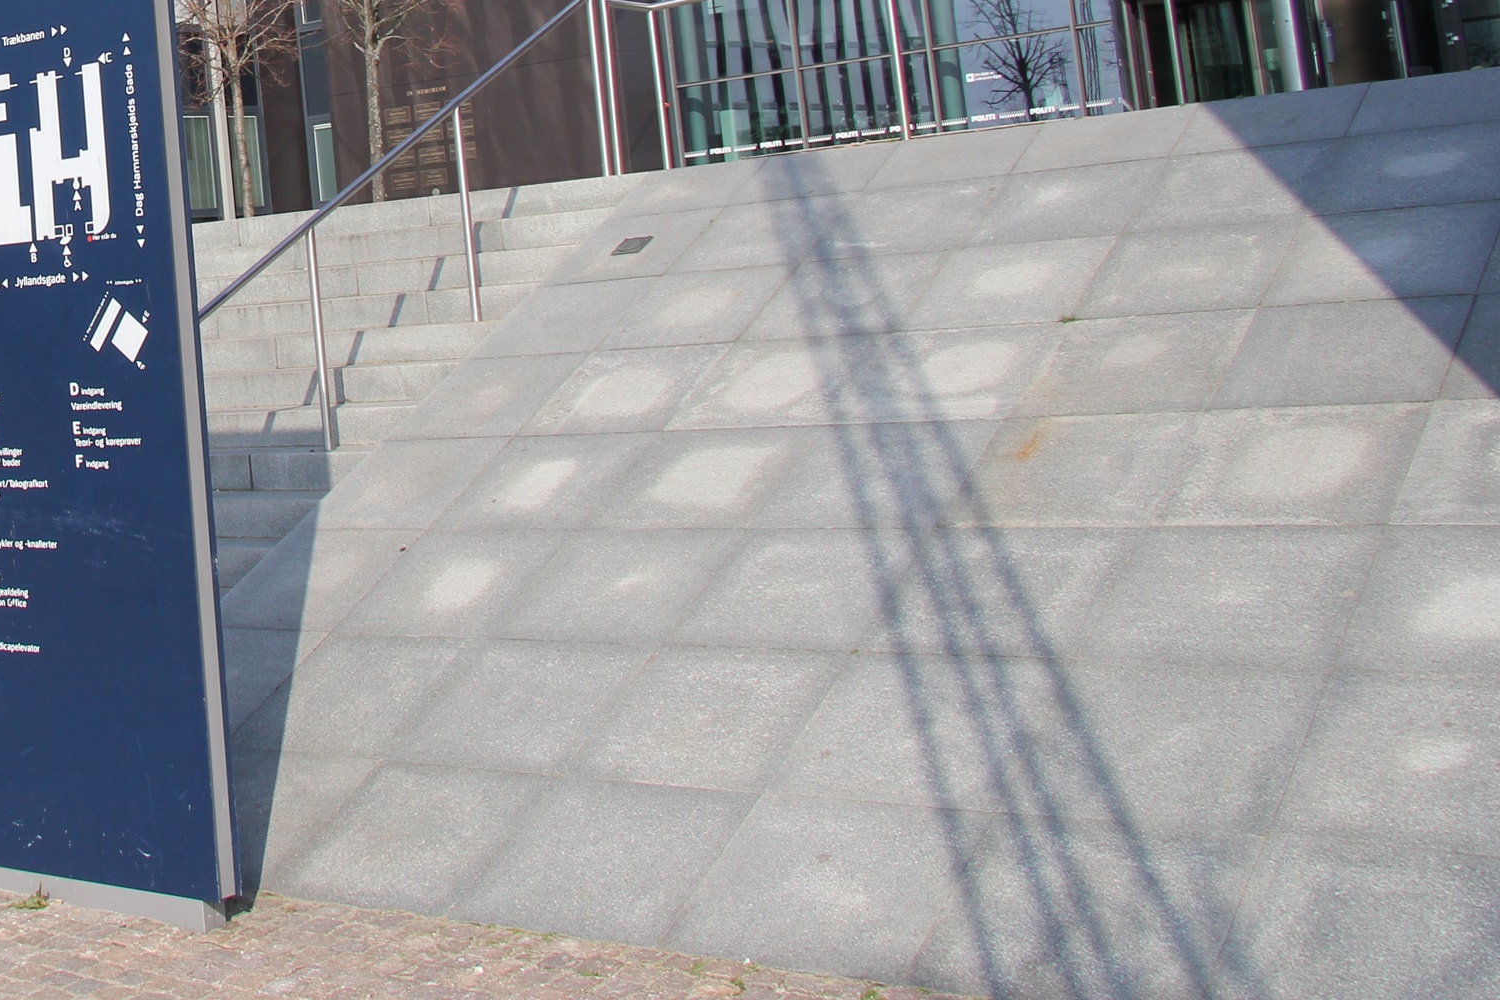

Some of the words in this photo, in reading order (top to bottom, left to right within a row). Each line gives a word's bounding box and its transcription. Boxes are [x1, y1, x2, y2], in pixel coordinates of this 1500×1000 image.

[1, 30, 45, 47] Trækbanen
[63, 47, 71, 58] D
[104, 51, 113, 63] C
[124, 64, 135, 95] Gade
[1029, 106, 1056, 116] POLITI
[971, 113, 996, 123] POLITI
[127, 98, 142, 190] Hammarskjølds
[74, 200, 82, 212] A
[134, 192, 145, 217] Dag
[30, 252, 38, 263] B
[14, 272, 66, 289] Jyllandsgade
[69, 382, 79, 396] D
[70, 400, 123, 412] Vareindlevering
[72, 420, 81, 435] E
[94, 438, 105, 449] og
[75, 454, 84, 469] F
[14, 540, 24, 550] og
